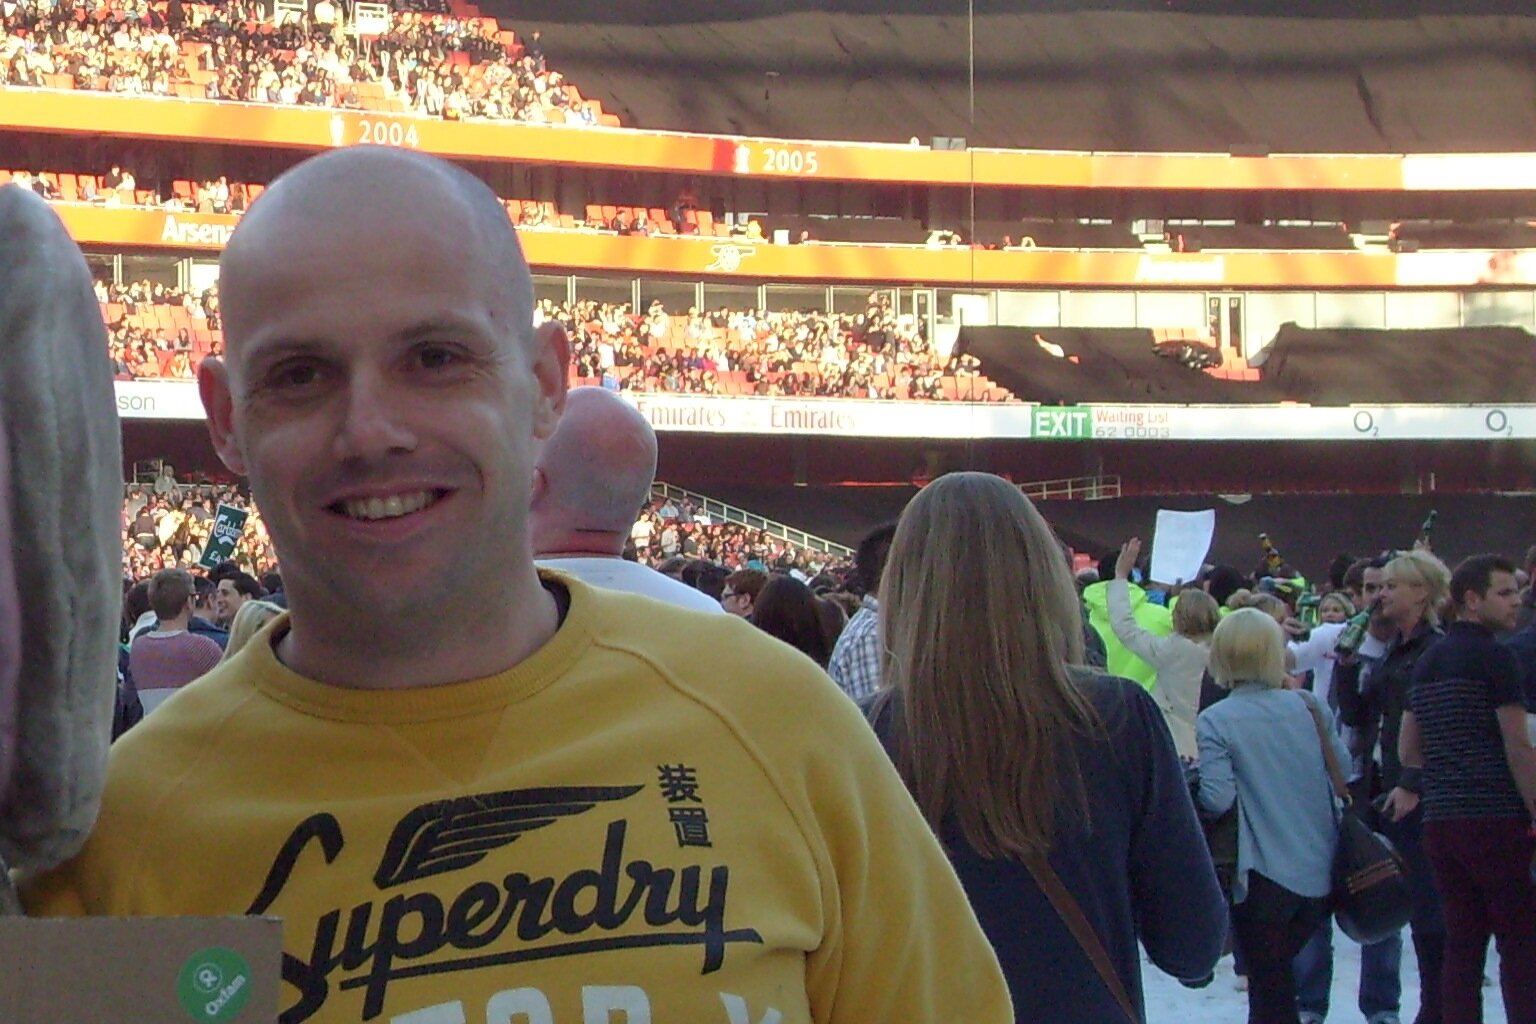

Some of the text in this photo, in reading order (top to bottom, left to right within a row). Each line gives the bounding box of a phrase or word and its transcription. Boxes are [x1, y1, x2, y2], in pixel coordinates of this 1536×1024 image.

[358, 120, 419, 148] 2004
[763, 147, 818, 174] 2005
[161, 214, 236, 244] Arsena
[771, 404, 856, 430] Emirates
[1035, 411, 1088, 437] EXIT
[1096, 410, 1144, 425] Waiting
[658, 763, 713, 848] 装置
[245, 812, 732, 1023] Superdry
[205, 974, 246, 1016] Oxfam
